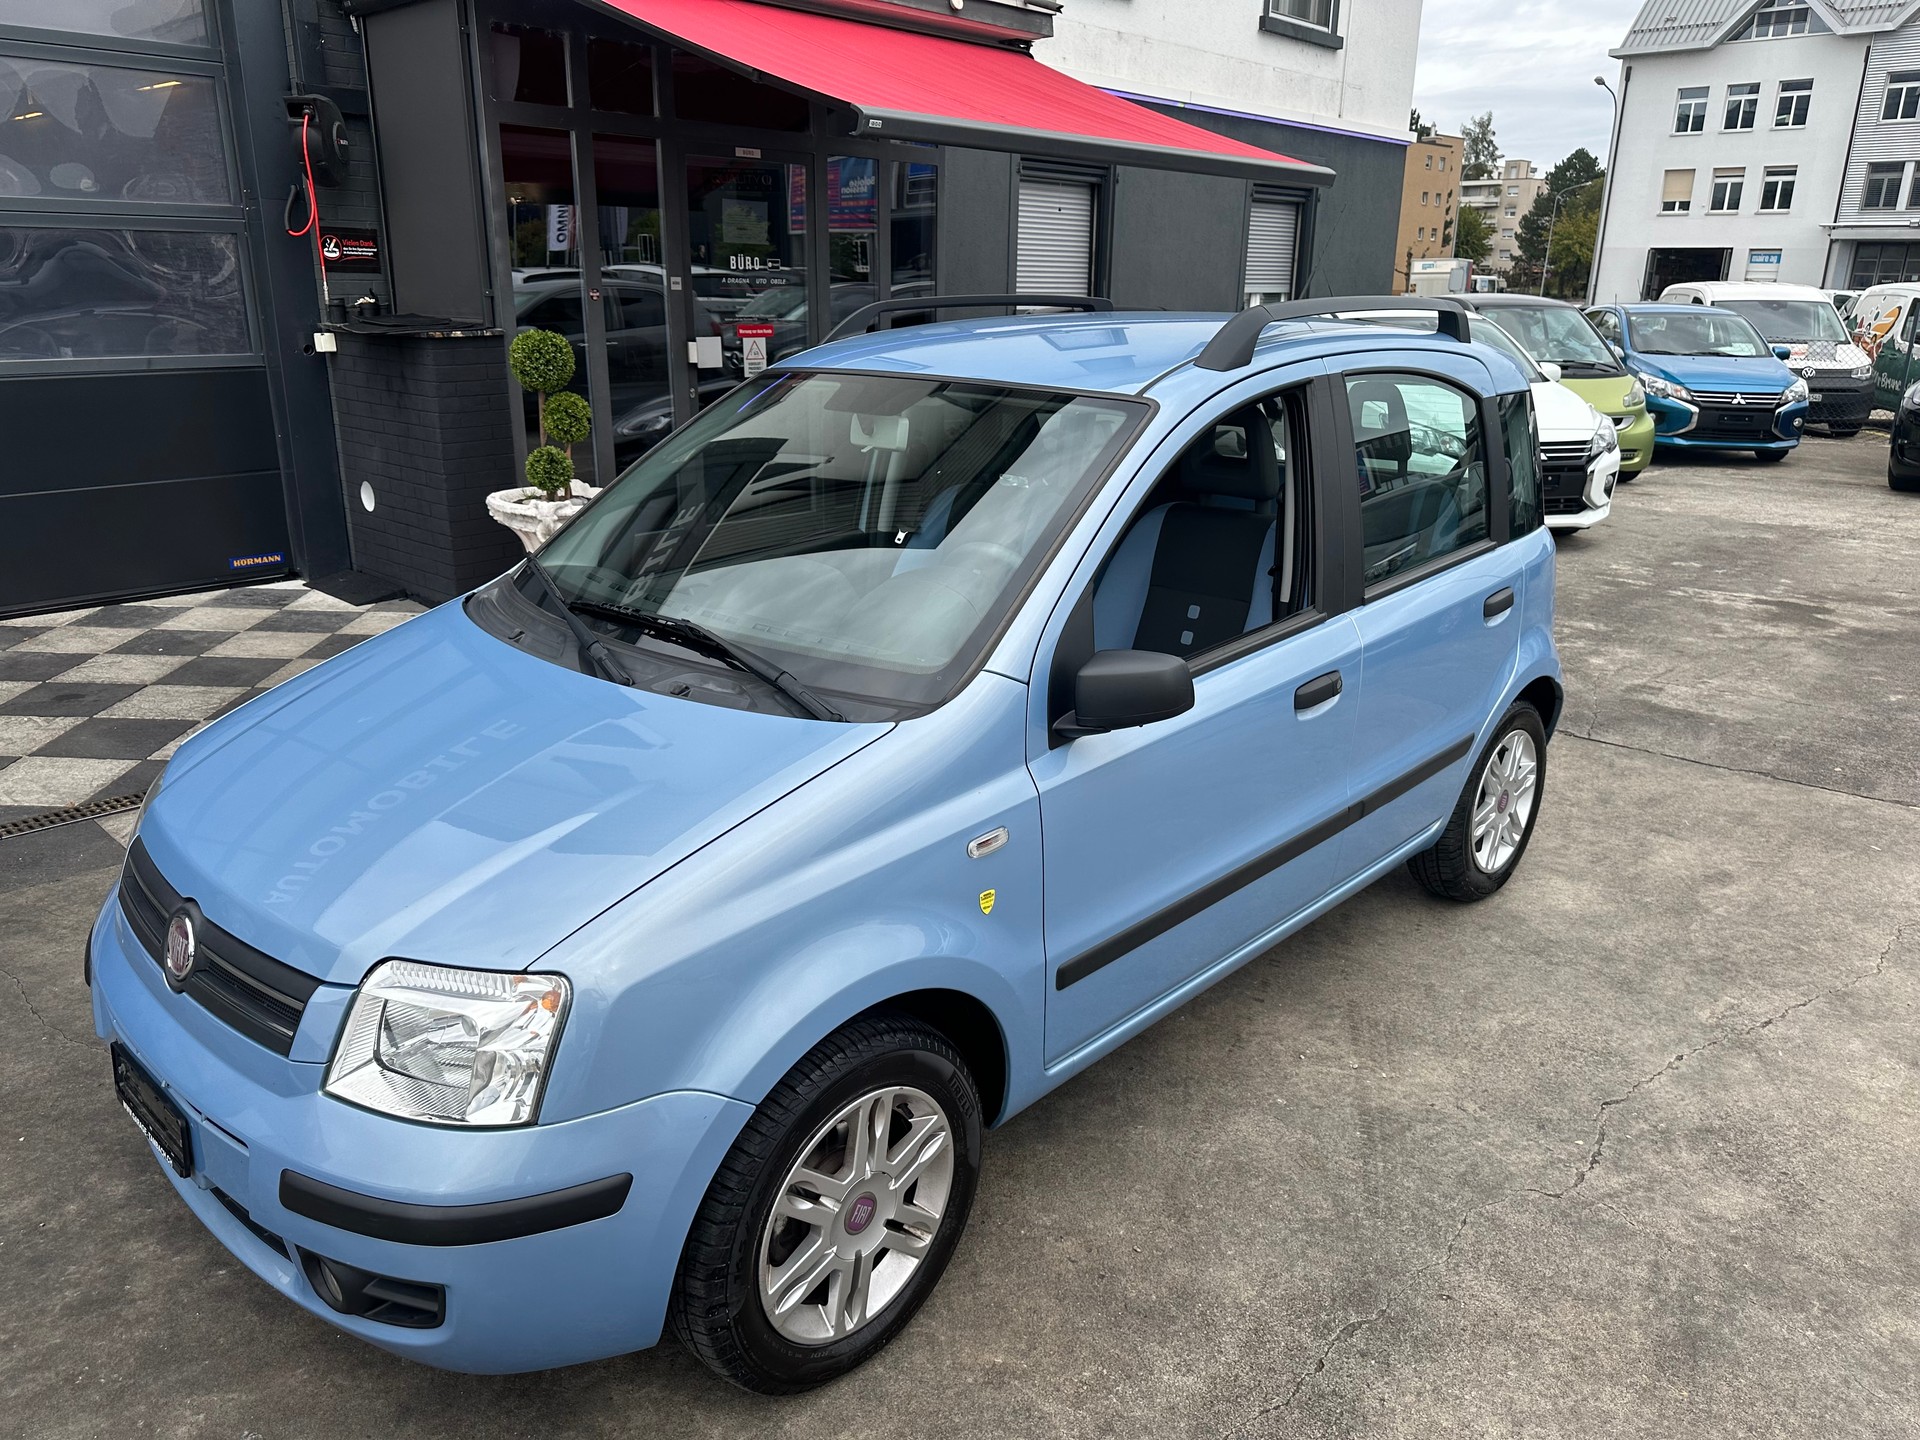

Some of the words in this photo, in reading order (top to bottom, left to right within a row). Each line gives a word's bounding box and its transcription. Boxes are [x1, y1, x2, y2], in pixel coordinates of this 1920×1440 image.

[729, 253, 760, 270] BÜRO
[168, 929, 188, 966] FIAT
[851, 1203, 873, 1225] FIAT
